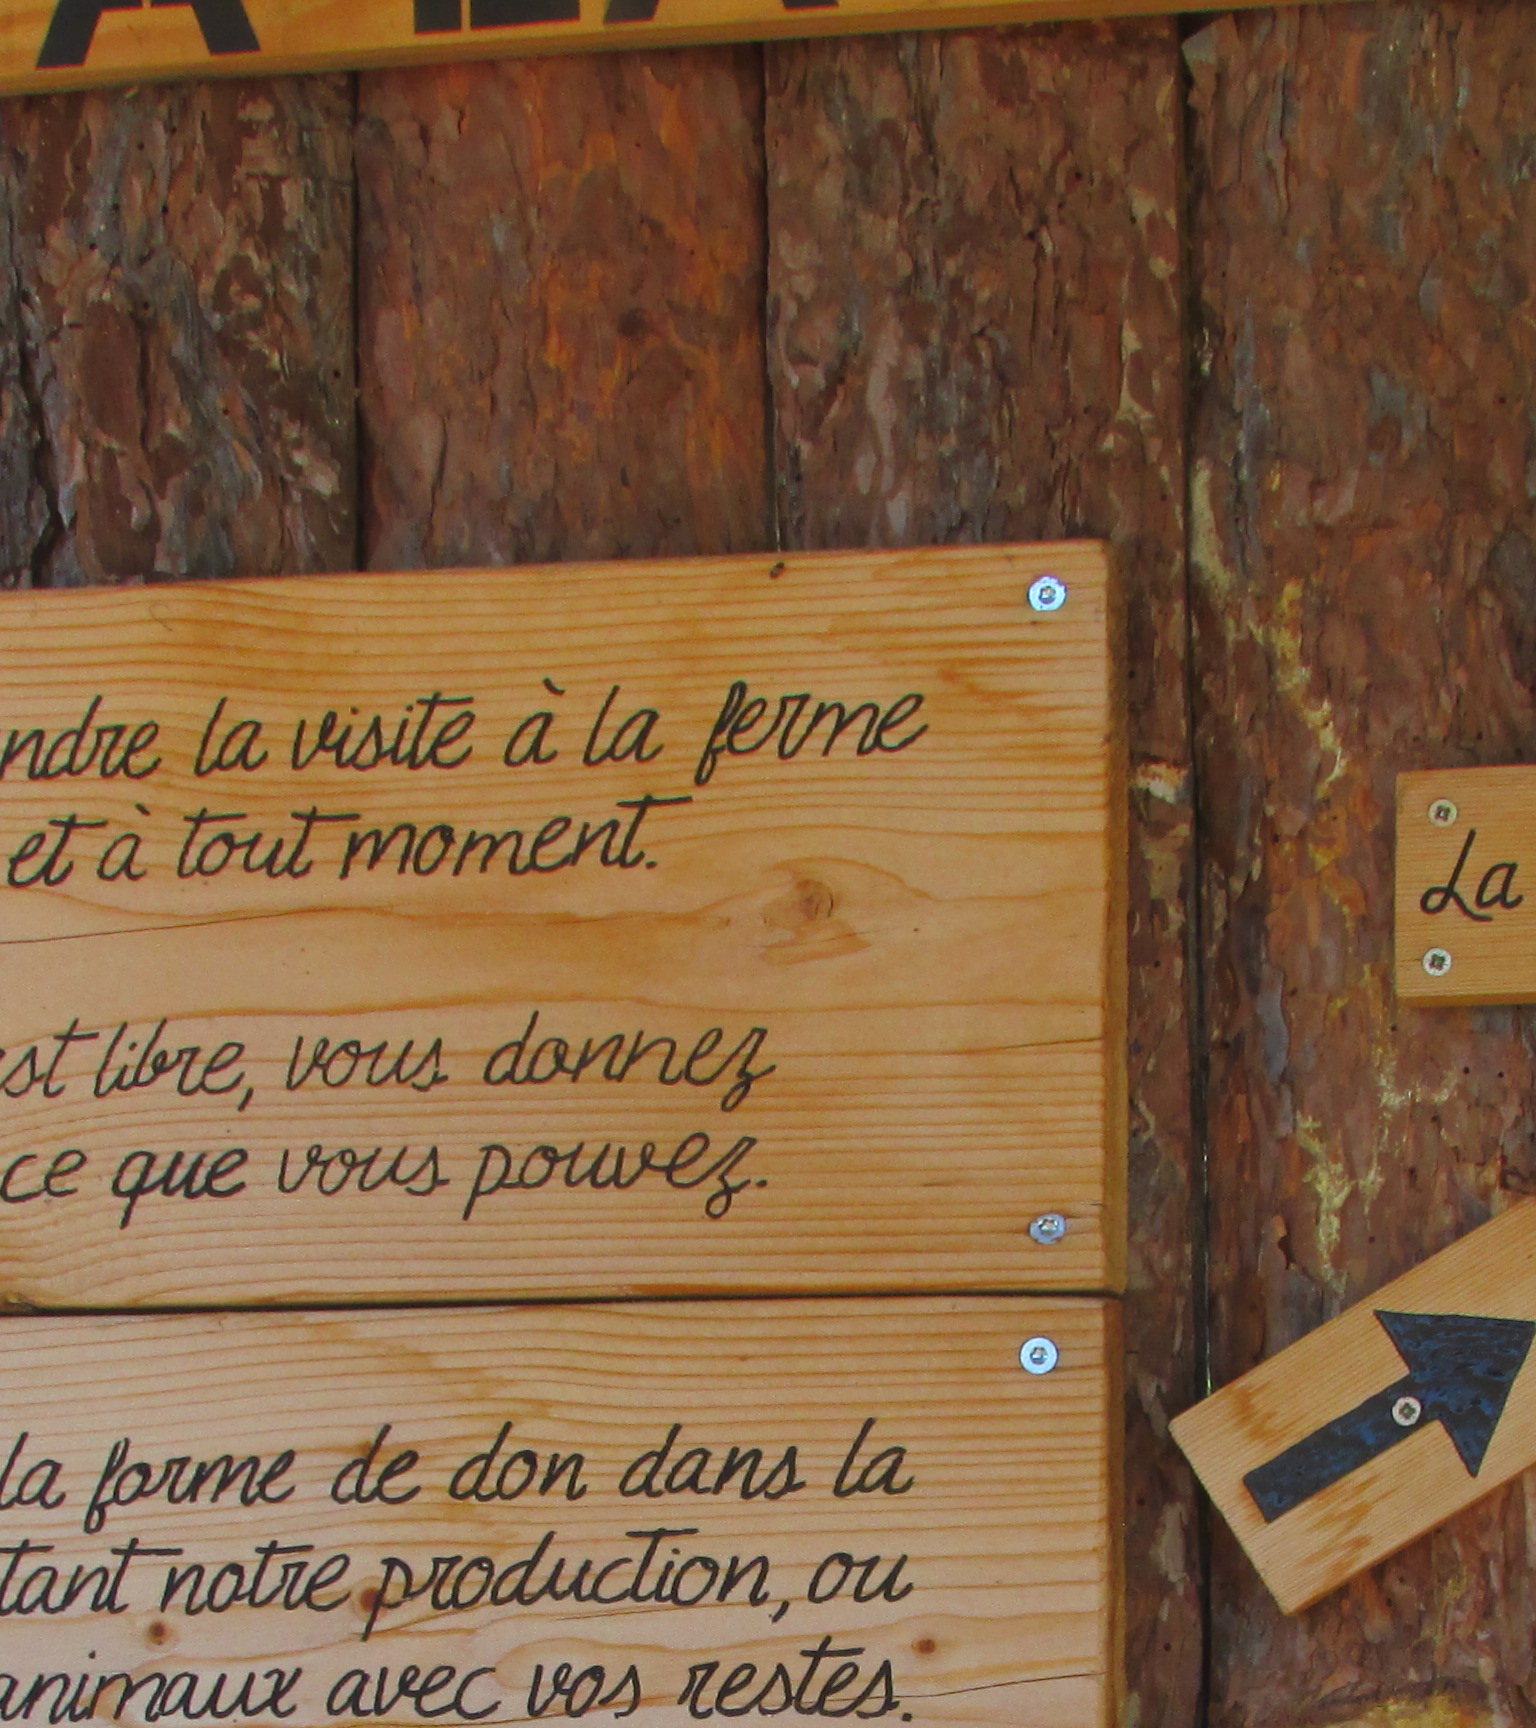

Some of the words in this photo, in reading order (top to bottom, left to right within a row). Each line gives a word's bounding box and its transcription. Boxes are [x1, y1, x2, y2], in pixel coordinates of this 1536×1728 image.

[195, 697, 268, 779] la
[296, 693, 476, 772] visite
[504, 680, 558, 766] à
[582, 685, 664, 766] la
[695, 681, 929, 787] ferme
[8, 815, 104, 889] et
[96, 805, 146, 881] à
[178, 806, 360, 878] tout
[342, 794, 693, 881] moment.
[1419, 827, 1524, 923] La
[94, 1018, 255, 1112] libre,
[285, 1033, 449, 1092] vous
[482, 1010, 777, 1112] donnez
[112, 1145, 251, 1229] que
[276, 1141, 450, 1198] vous
[462, 1130, 770, 1221] pouvez.
[84, 1436, 296, 1534] forme
[330, 1422, 424, 1506] de
[448, 1419, 587, 1505] don
[619, 1422, 807, 1499] dans
[833, 1417, 915, 1498] la
[158, 1540, 352, 1615] notre
[361, 1527, 790, 1643] production,
[807, 1549, 917, 1608] ou
[326, 1663, 506, 1721] avec
[527, 1665, 643, 1719] vos
[680, 1635, 915, 1724] restes.
